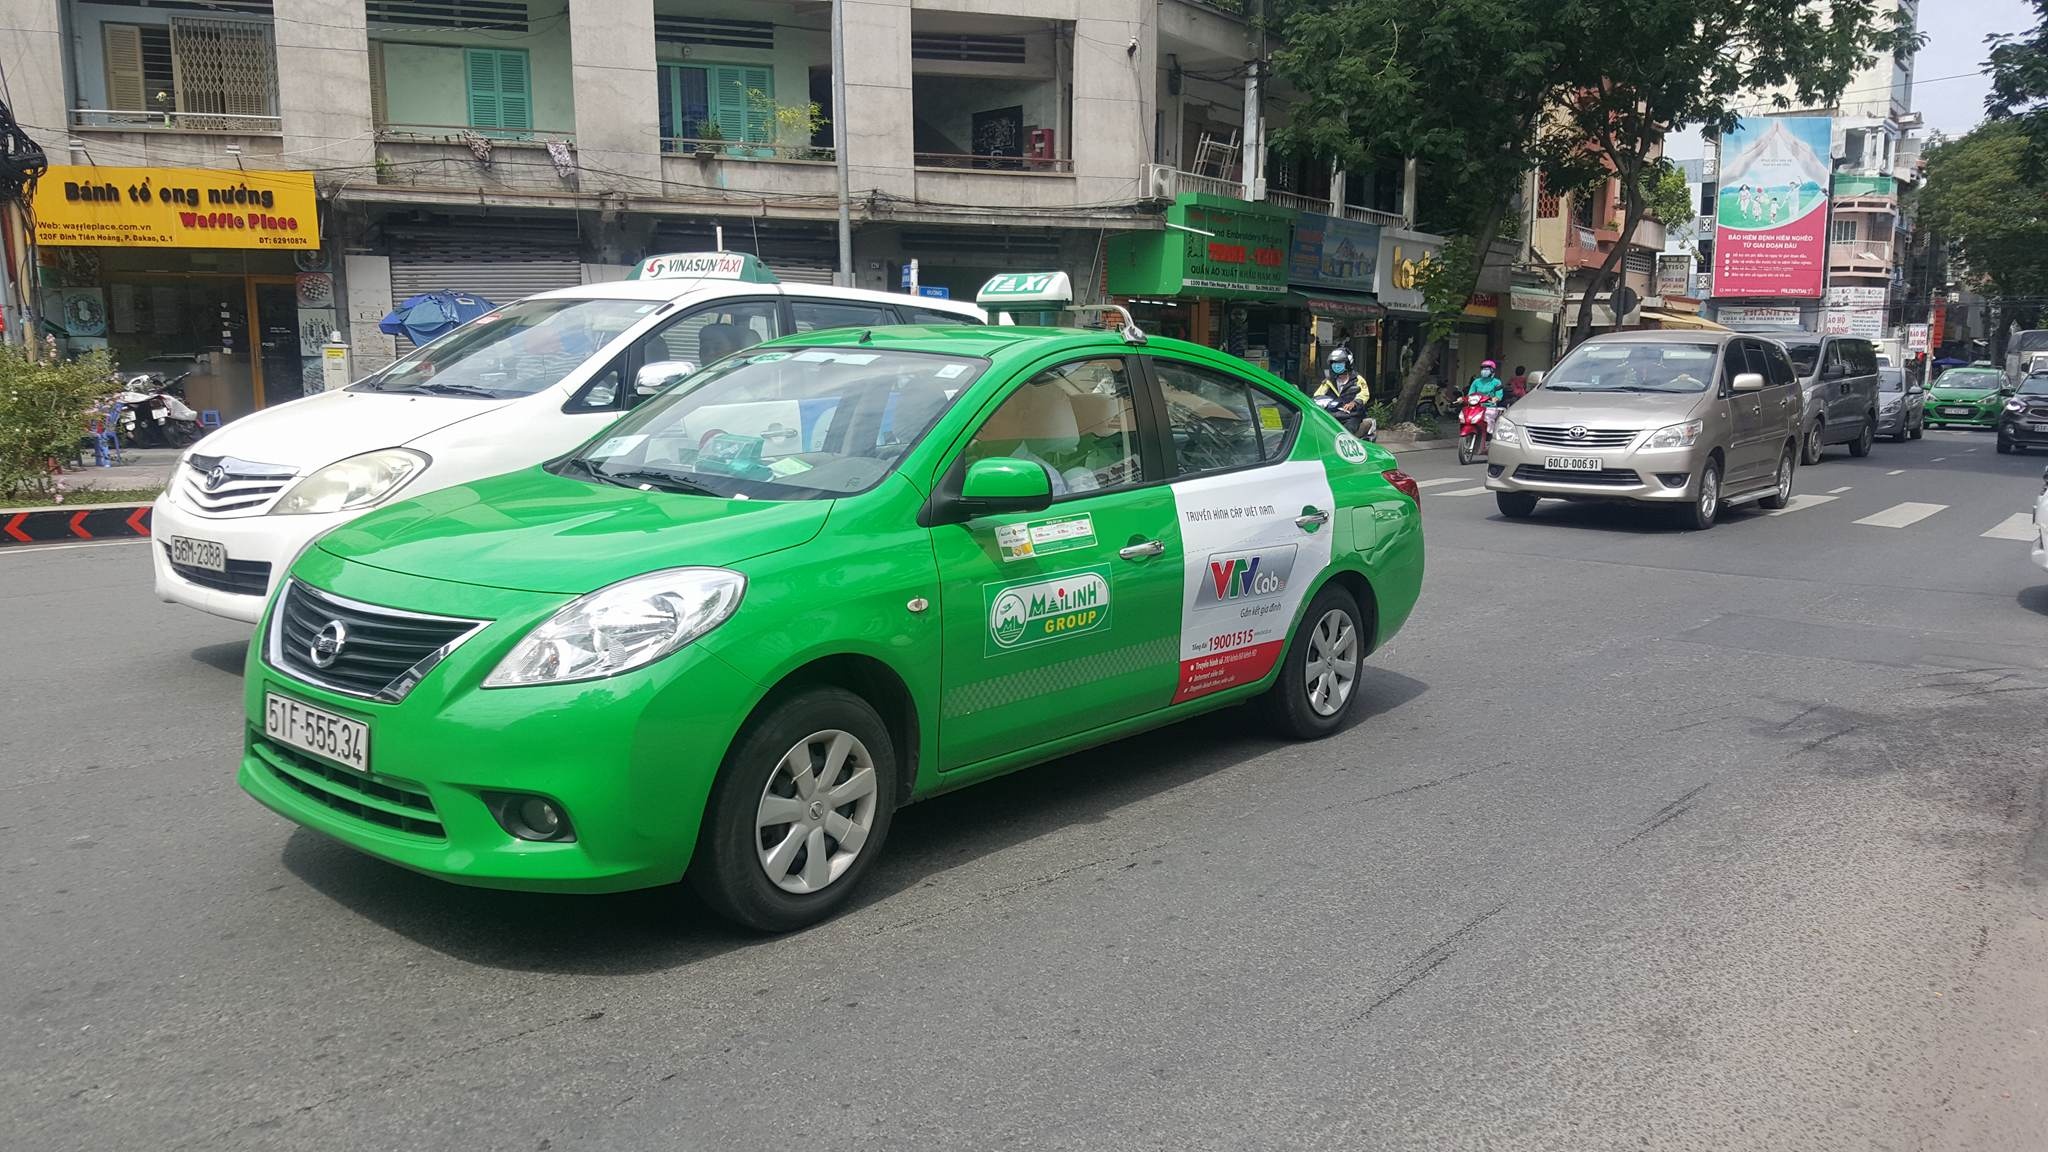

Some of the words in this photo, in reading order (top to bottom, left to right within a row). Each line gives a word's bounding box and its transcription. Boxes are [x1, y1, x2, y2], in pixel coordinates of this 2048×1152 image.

[159, 187, 199, 207] ong
[37, 222, 60, 230] Web:
[63, 222, 152, 231] waffleplace.com.vn
[179, 212, 245, 229] Waffle
[247, 213, 298, 230] Place
[1338, 438, 1366, 457] 6232
[1044, 610, 1098, 634] GROUP
[1209, 629, 1254, 652] 19001515
[269, 698, 362, 766] 51F-555.34
